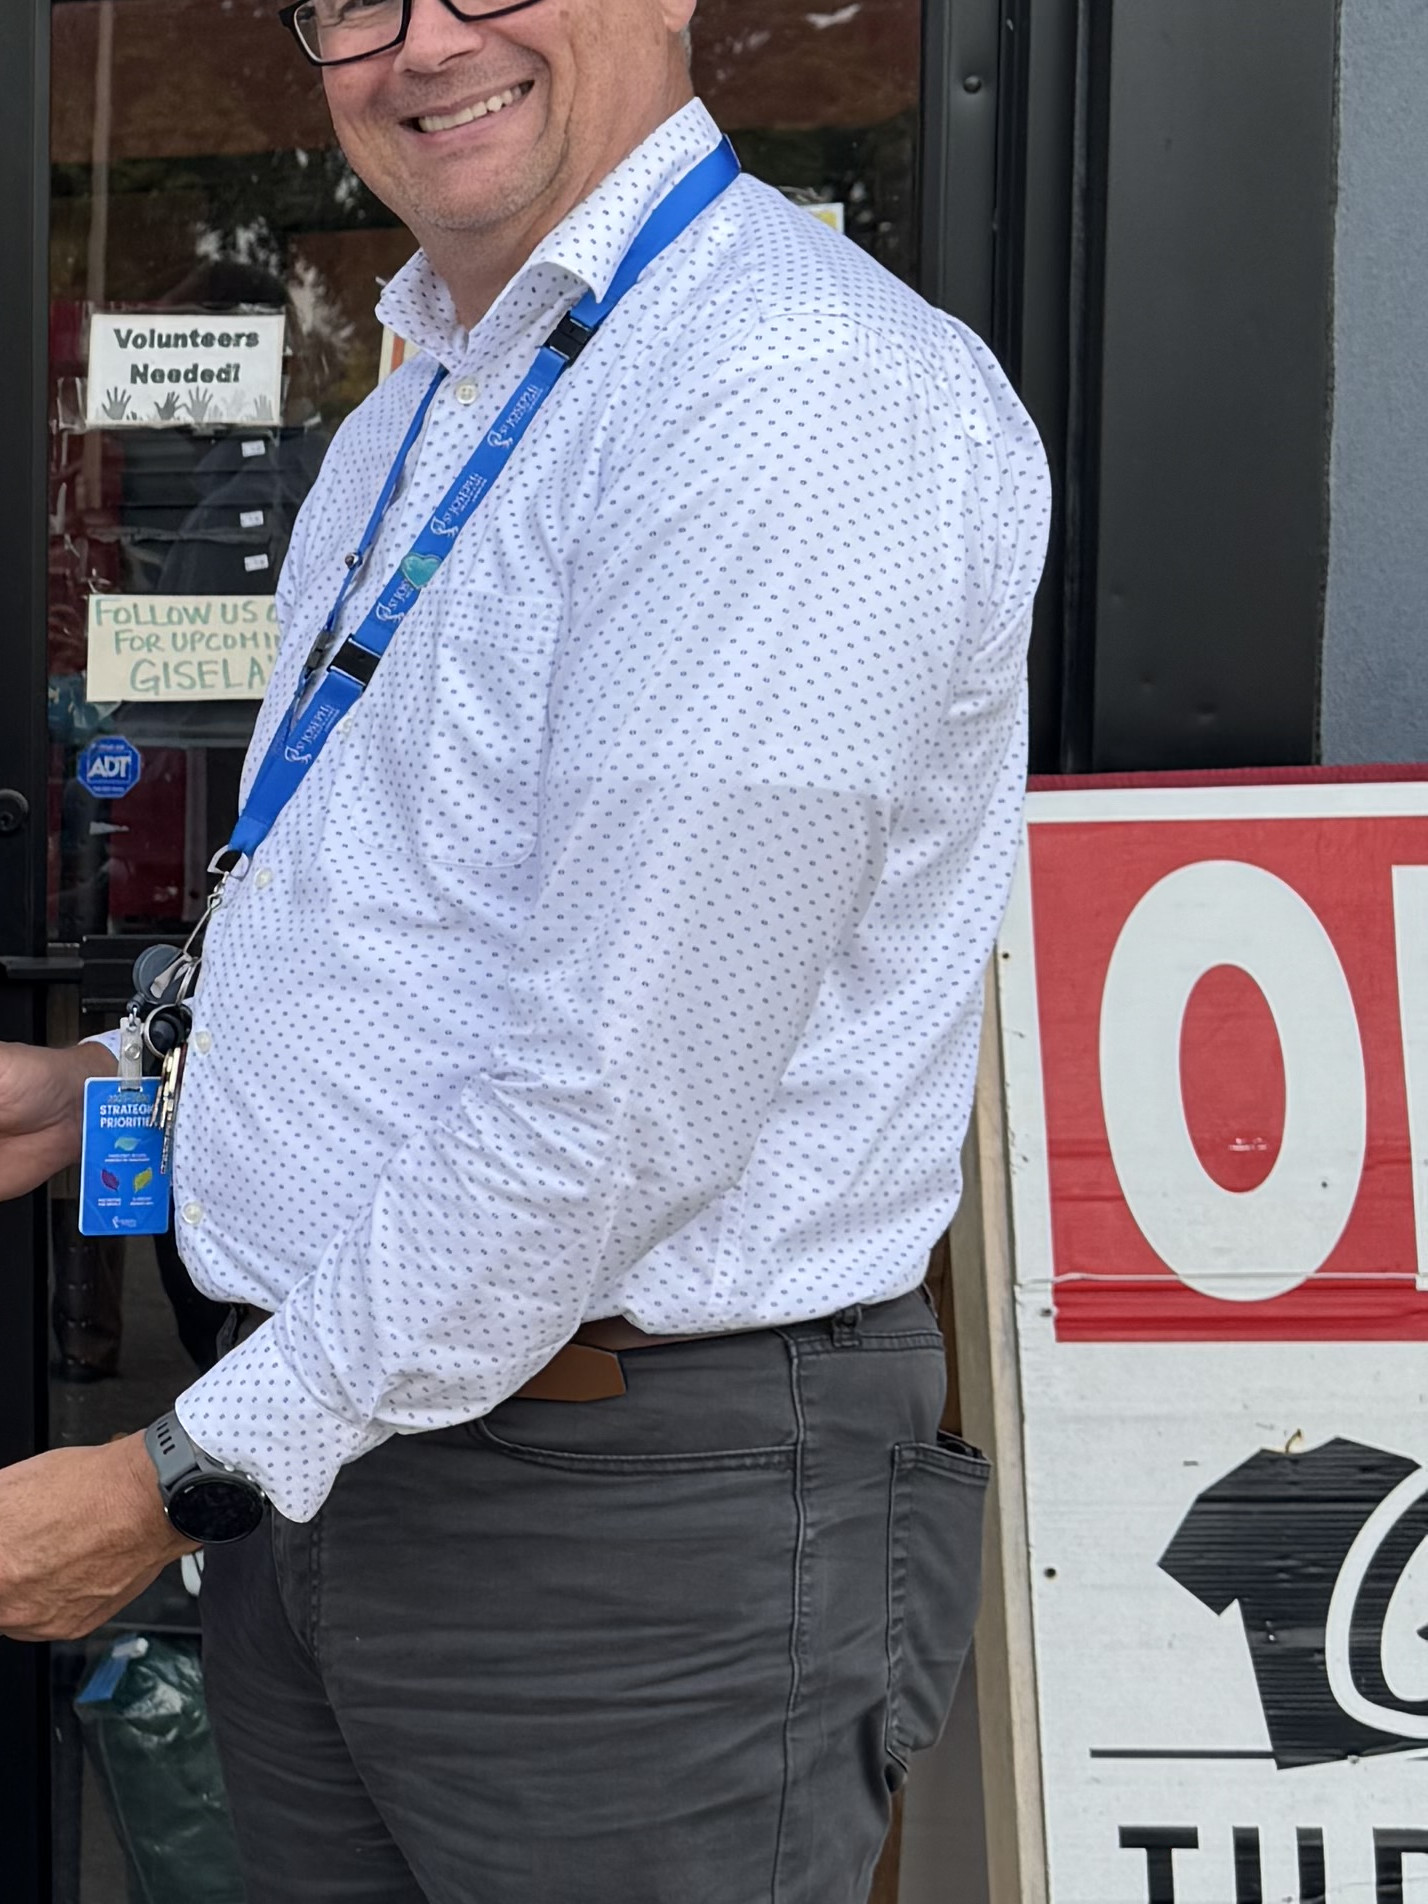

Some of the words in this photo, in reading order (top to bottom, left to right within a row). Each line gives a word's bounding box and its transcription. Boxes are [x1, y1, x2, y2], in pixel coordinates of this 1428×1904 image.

[113, 328, 260, 349] Volunteers
[130, 363, 241, 384] Needed!
[95, 599, 212, 626] FOLLOW
[220, 600, 258, 625] US
[115, 629, 165, 655] FOR
[130, 656, 273, 696] GISELA'
[87, 756, 131, 778] ADT
